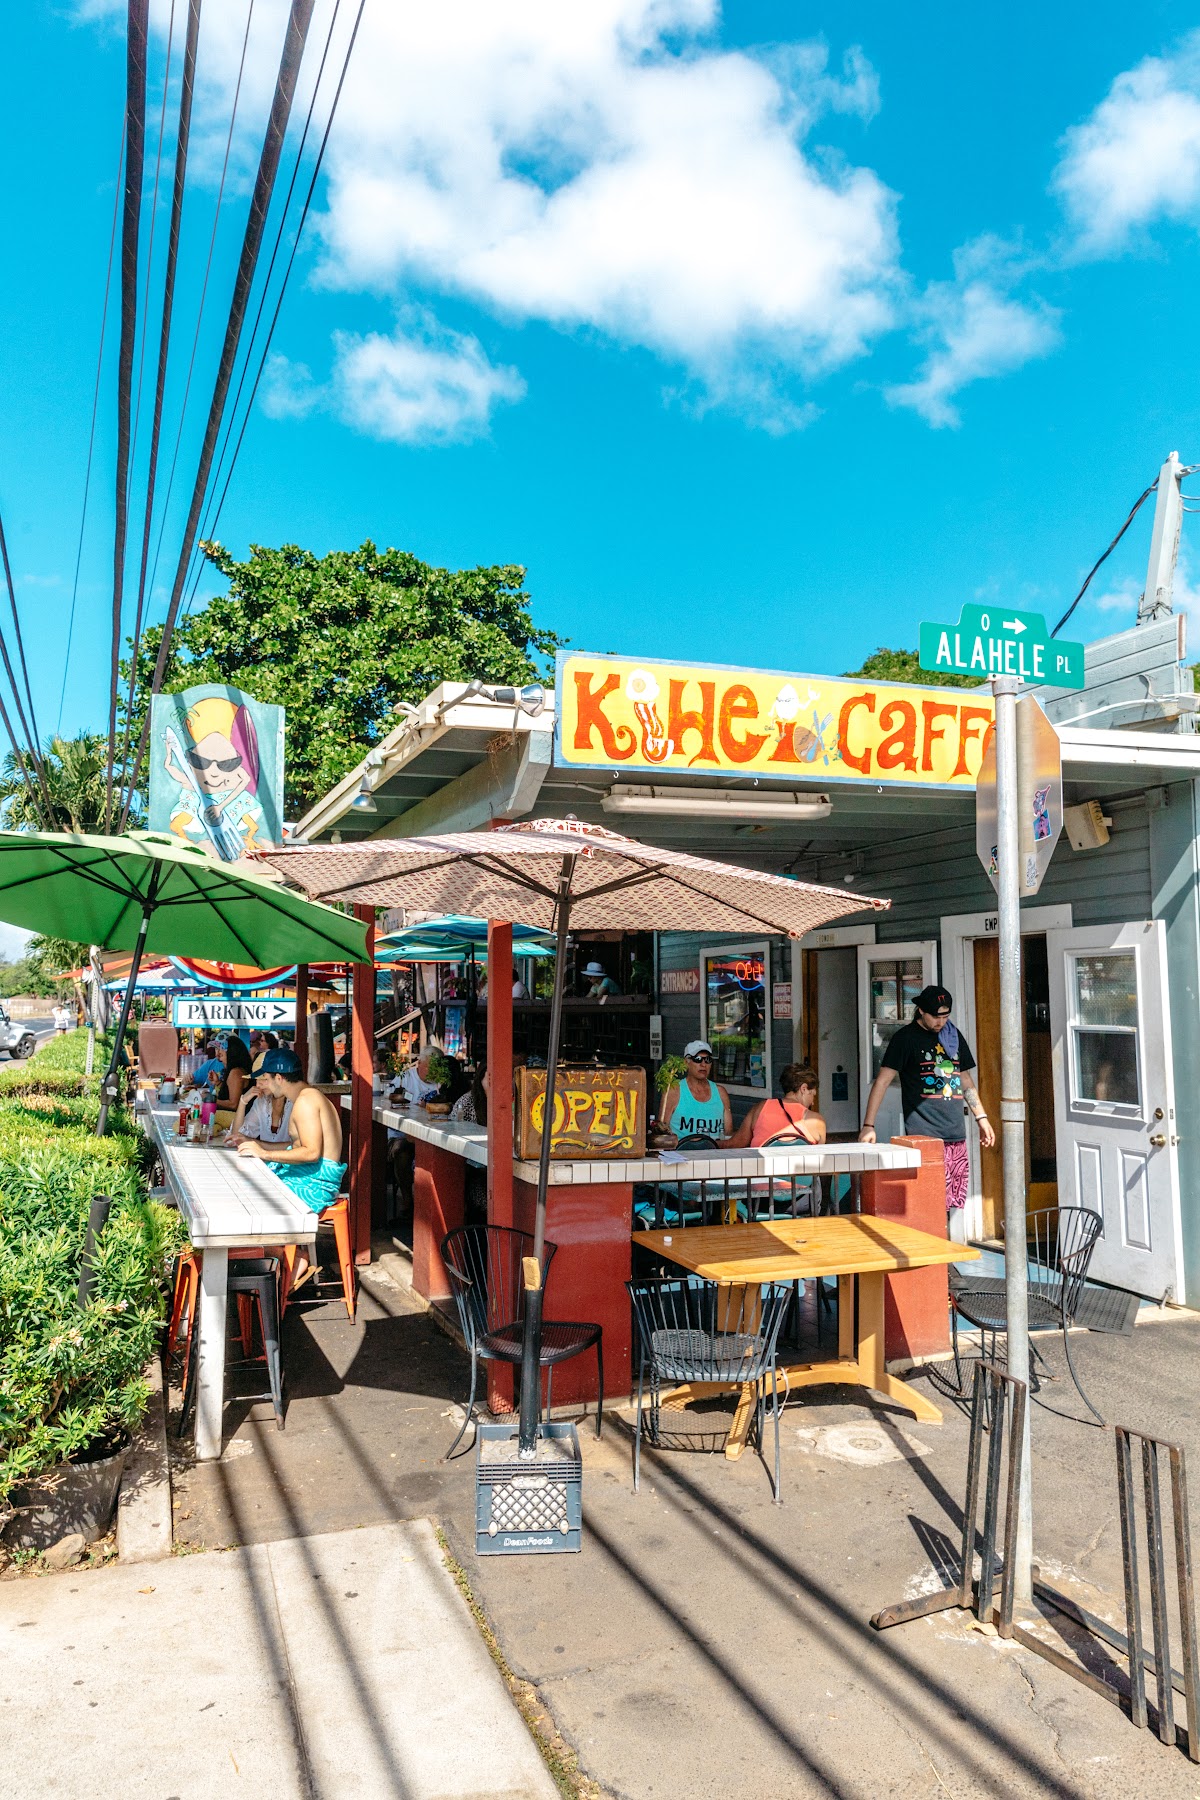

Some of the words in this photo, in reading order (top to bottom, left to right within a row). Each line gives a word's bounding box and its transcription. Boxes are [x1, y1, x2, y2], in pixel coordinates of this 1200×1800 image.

[936, 631, 1045, 678] ALAHELE
[1056, 655, 1071, 673] PL
[985, 917, 998, 930] EMP
[661, 971, 692, 991] ENTRANCE
[188, 1004, 267, 1019] PARKING
[774, 1003, 791, 1013] FIRST
[532, 1074, 560, 1086] YS
[566, 1072, 586, 1084] WE
[592, 1071, 624, 1086] ARE
[530, 1089, 638, 1136] OPEN
